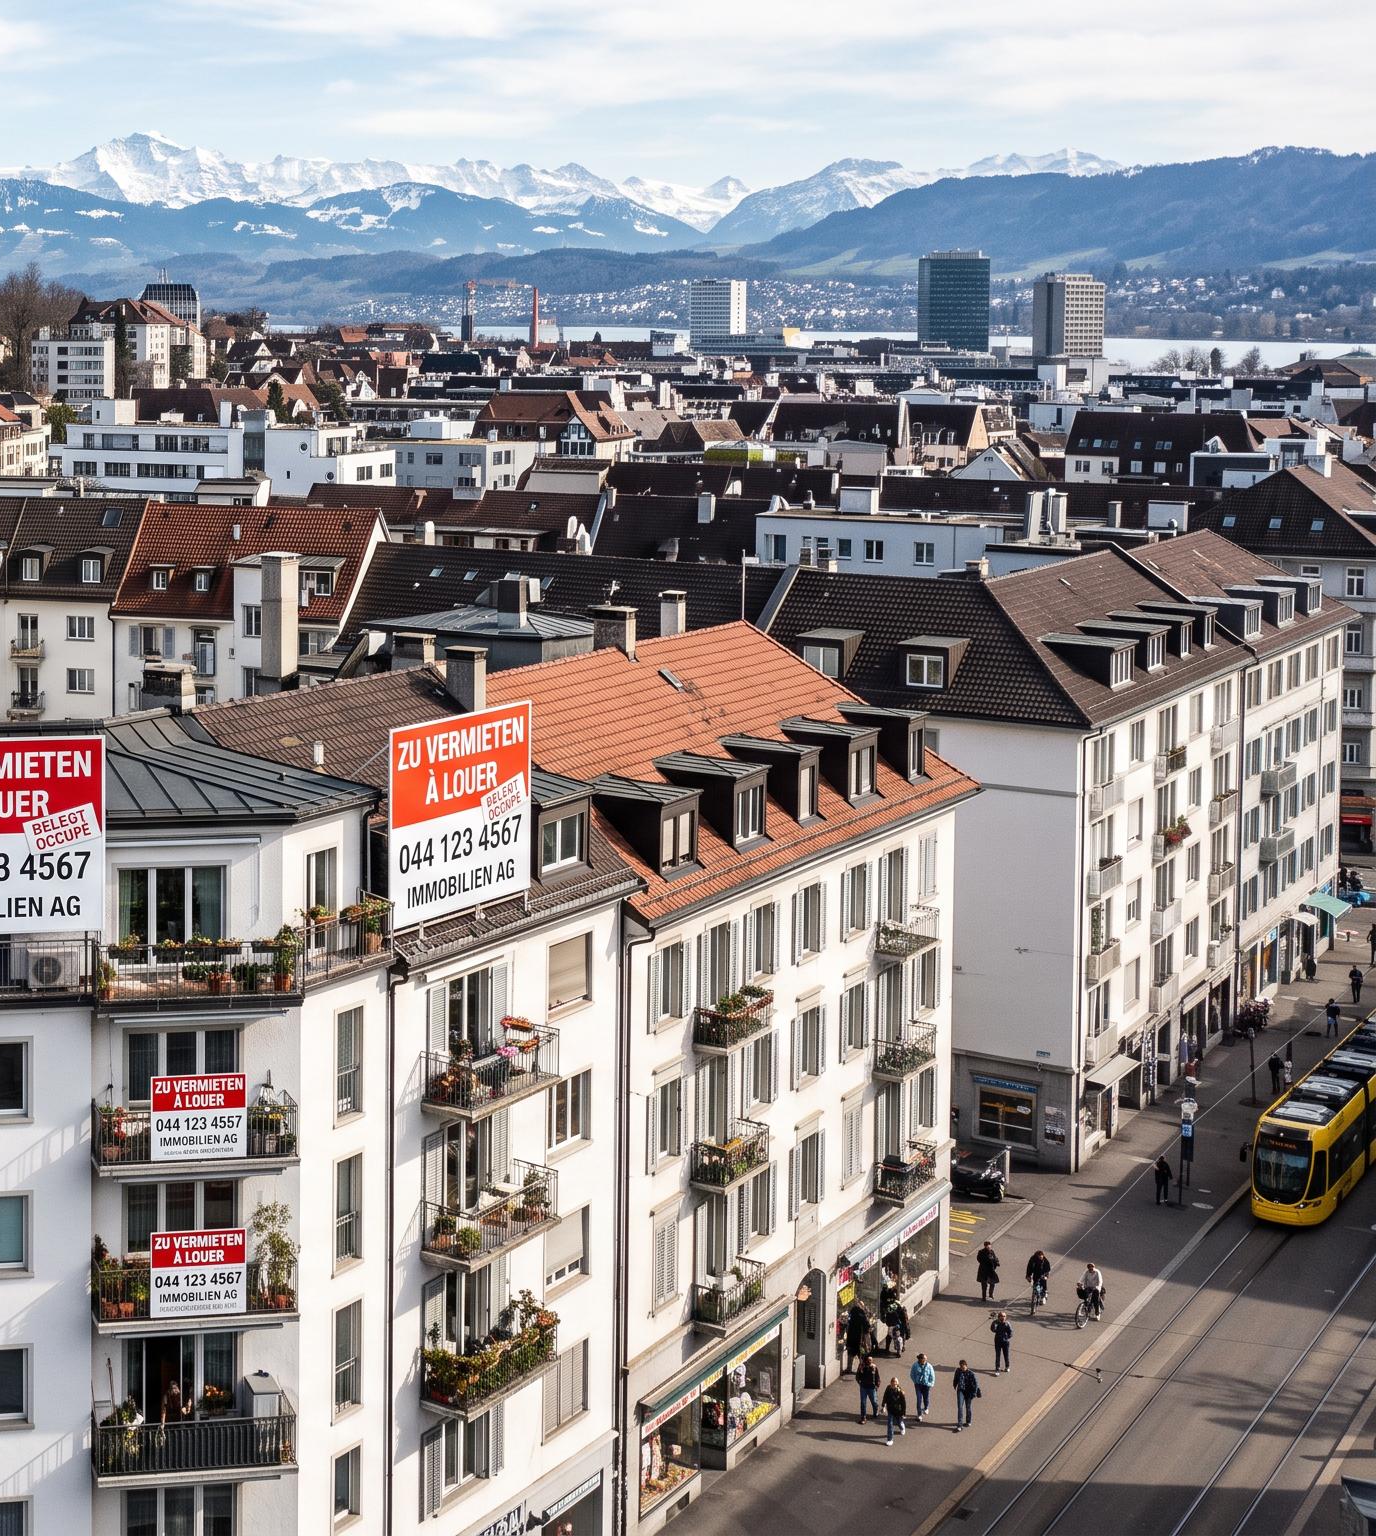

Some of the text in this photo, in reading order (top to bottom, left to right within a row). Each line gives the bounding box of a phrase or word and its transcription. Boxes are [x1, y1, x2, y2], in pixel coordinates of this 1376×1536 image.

[398, 716, 523, 771] ZU VERMIETEN
[425, 761, 497, 805] À LOUER
[32, 810, 85, 835] BELEGT
[400, 814, 521, 874] 044 123 4567
[20, 852, 90, 880] 4567
[408, 859, 514, 908] IMMOBILIEN AG
[50, 896, 81, 916] AG
[155, 1078, 243, 1094] ZU VERMIETEN
[186, 1094, 224, 1108] LOUER
[156, 1118, 180, 1132] 044
[184, 1117, 207, 1130] 123
[160, 1134, 237, 1146] IMMOBILIEN AG
[155, 1233, 242, 1249] ZU VERMIETEN
[186, 1249, 224, 1263] LOUER
[155, 1272, 241, 1288] 044 123 4567
[160, 1290, 237, 1303] IMMOBILIEN AG
